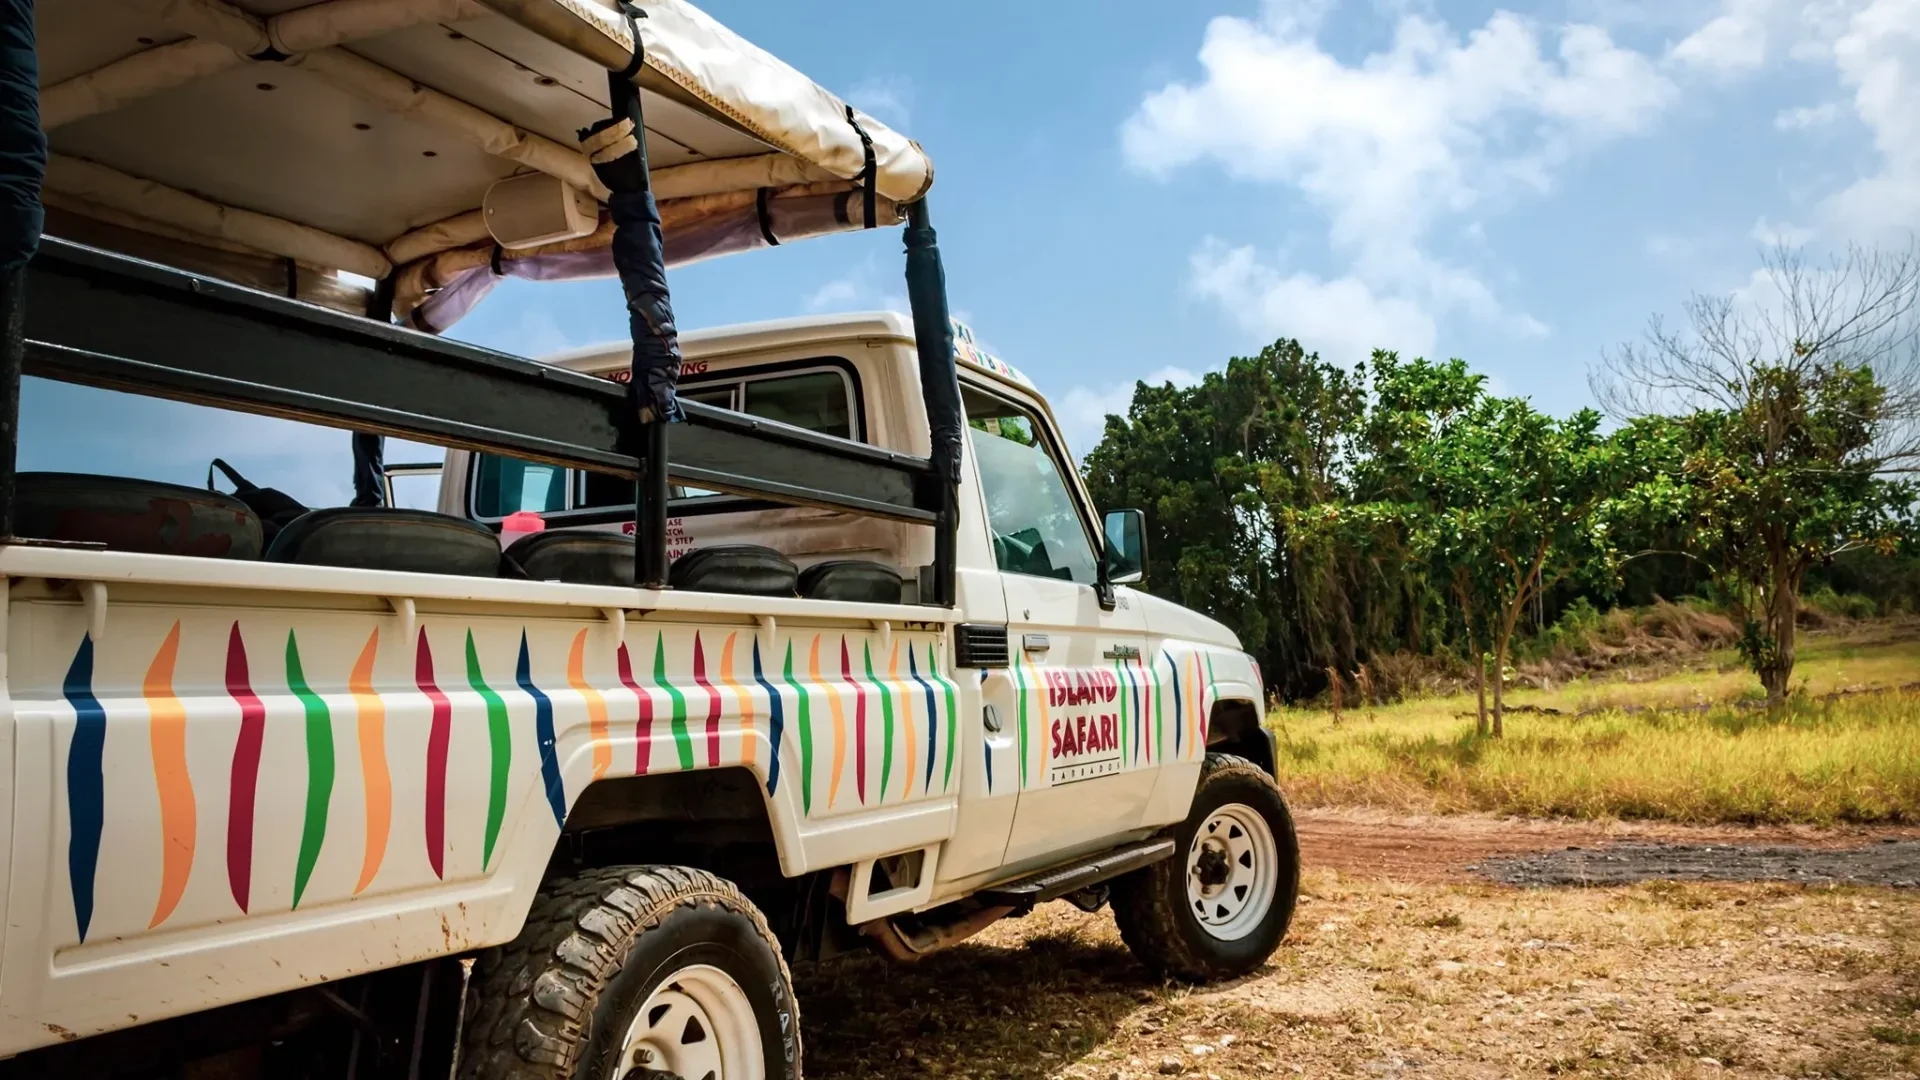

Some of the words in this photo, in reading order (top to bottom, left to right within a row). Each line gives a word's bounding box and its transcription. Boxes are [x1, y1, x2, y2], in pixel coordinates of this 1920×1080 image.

[675, 536, 695, 545] STEP
[1044, 668, 1118, 707] ISLAND
[1051, 713, 1119, 759] SAFARI
[1052, 762, 1120, 782] BARBADOS
